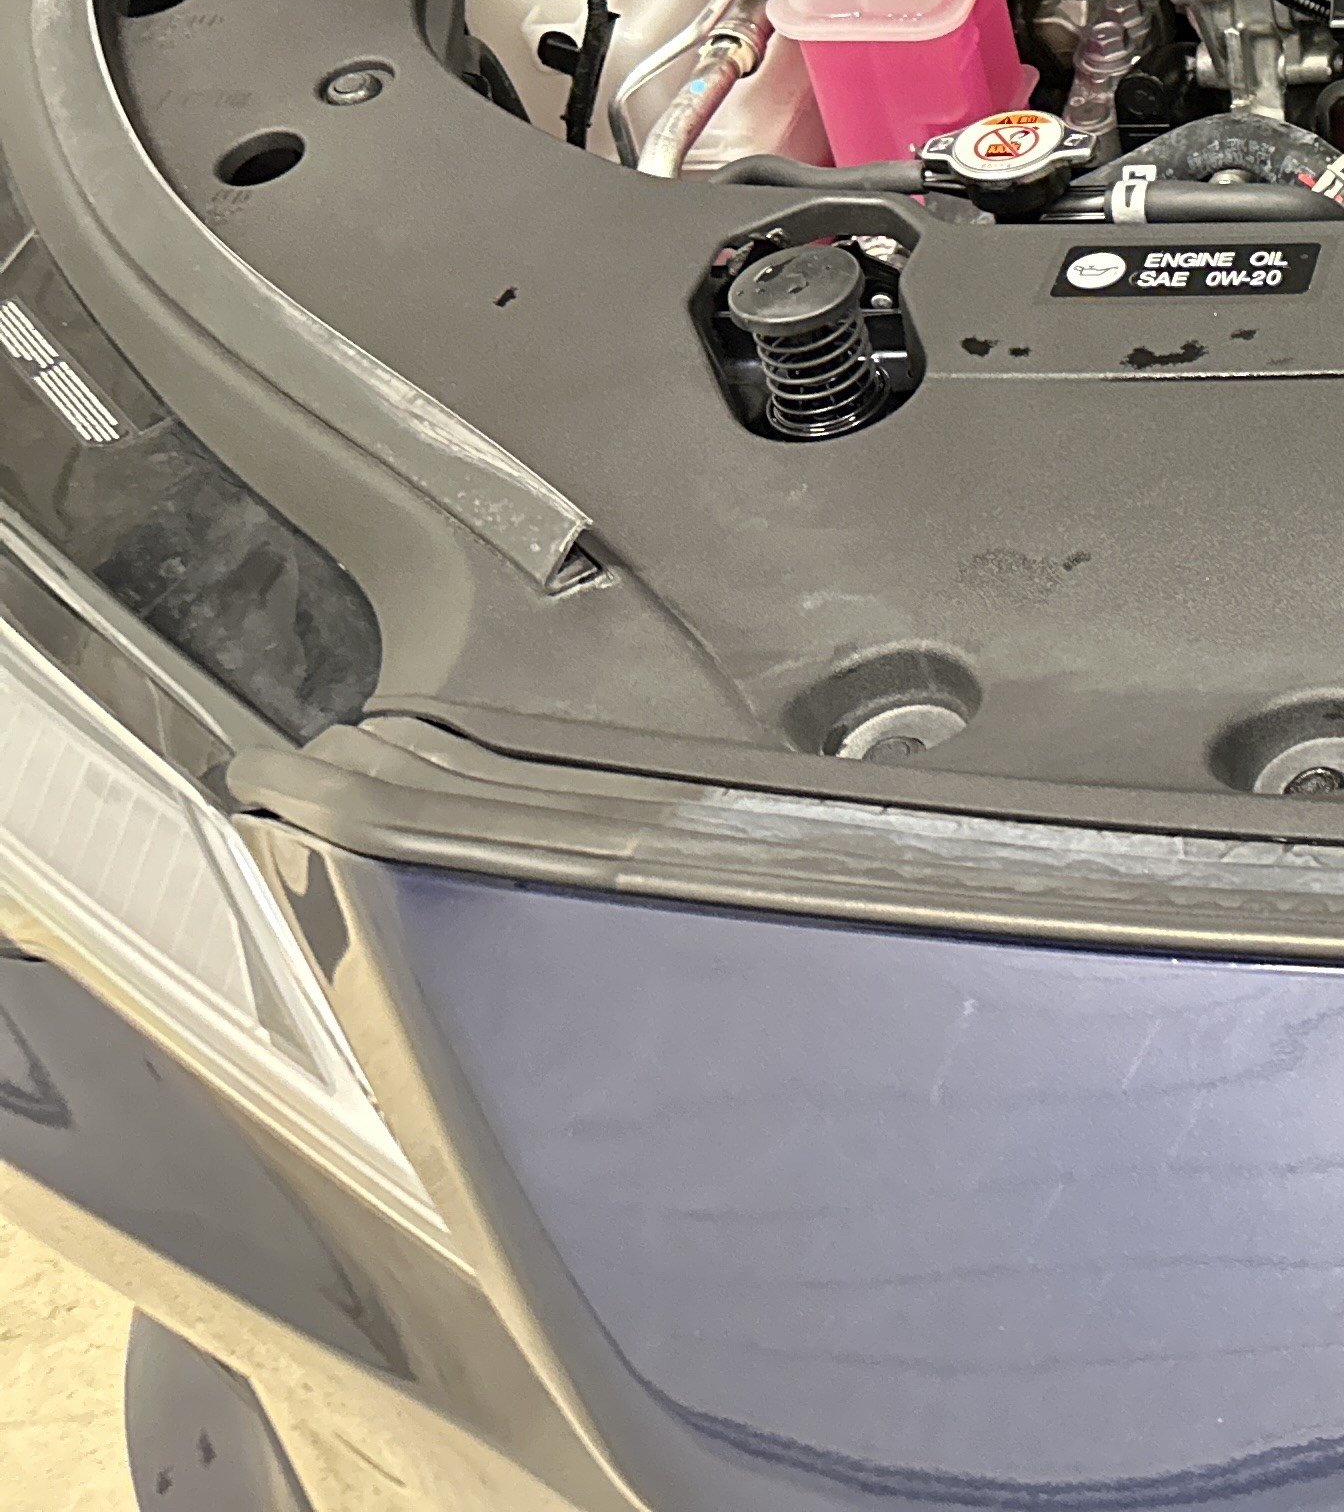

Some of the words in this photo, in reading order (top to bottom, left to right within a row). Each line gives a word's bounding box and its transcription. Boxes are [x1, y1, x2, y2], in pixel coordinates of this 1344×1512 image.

[1144, 251, 1235, 268] ENGINE
[1249, 251, 1289, 266] OIL
[1137, 271, 1189, 287] SAE
[1205, 270, 1282, 287] 0W-20
